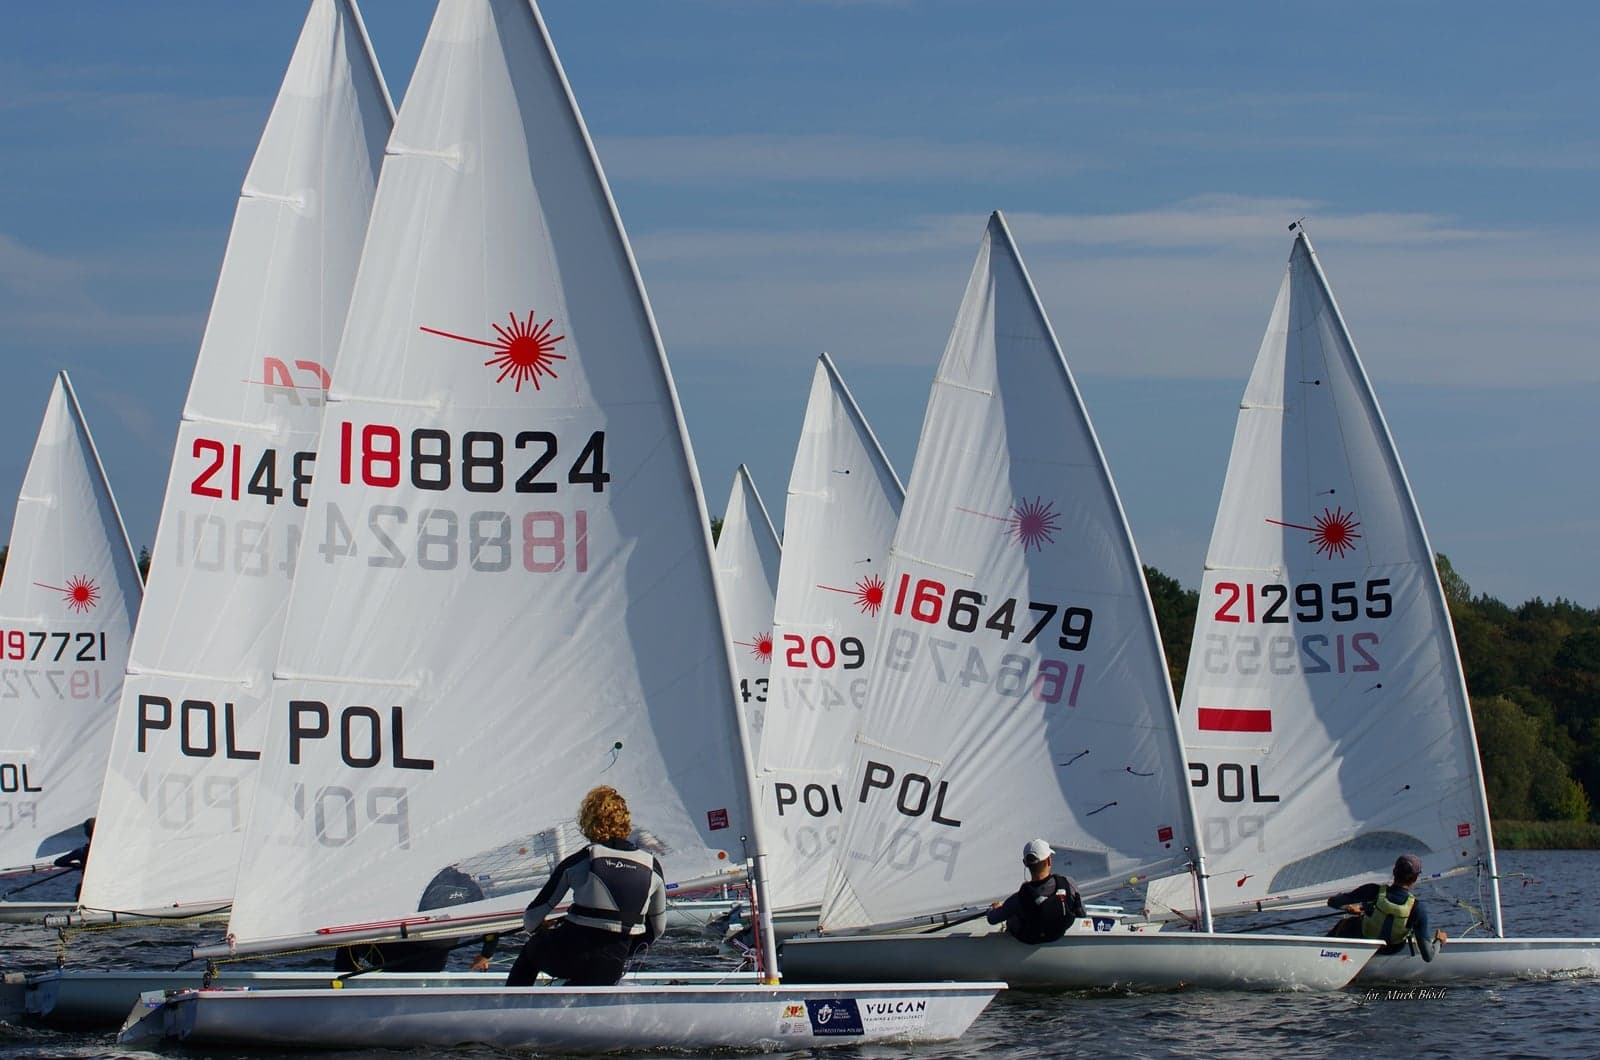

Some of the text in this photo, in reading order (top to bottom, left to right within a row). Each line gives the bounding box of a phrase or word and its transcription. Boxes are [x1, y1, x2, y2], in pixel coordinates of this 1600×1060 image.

[340, 422, 610, 493] 188824
[894, 573, 1093, 651] 166479
[1214, 578, 1392, 624] 212955
[0, 630, 106, 662] 197721
[784, 634, 865, 669] 209
[138, 694, 260, 760] POL
[289, 701, 434, 770] POL
[859, 761, 961, 827] POL
[1188, 762, 1280, 802] POL
[1320, 949, 1341, 958] Laser
[866, 1001, 926, 1014] VULCAN
